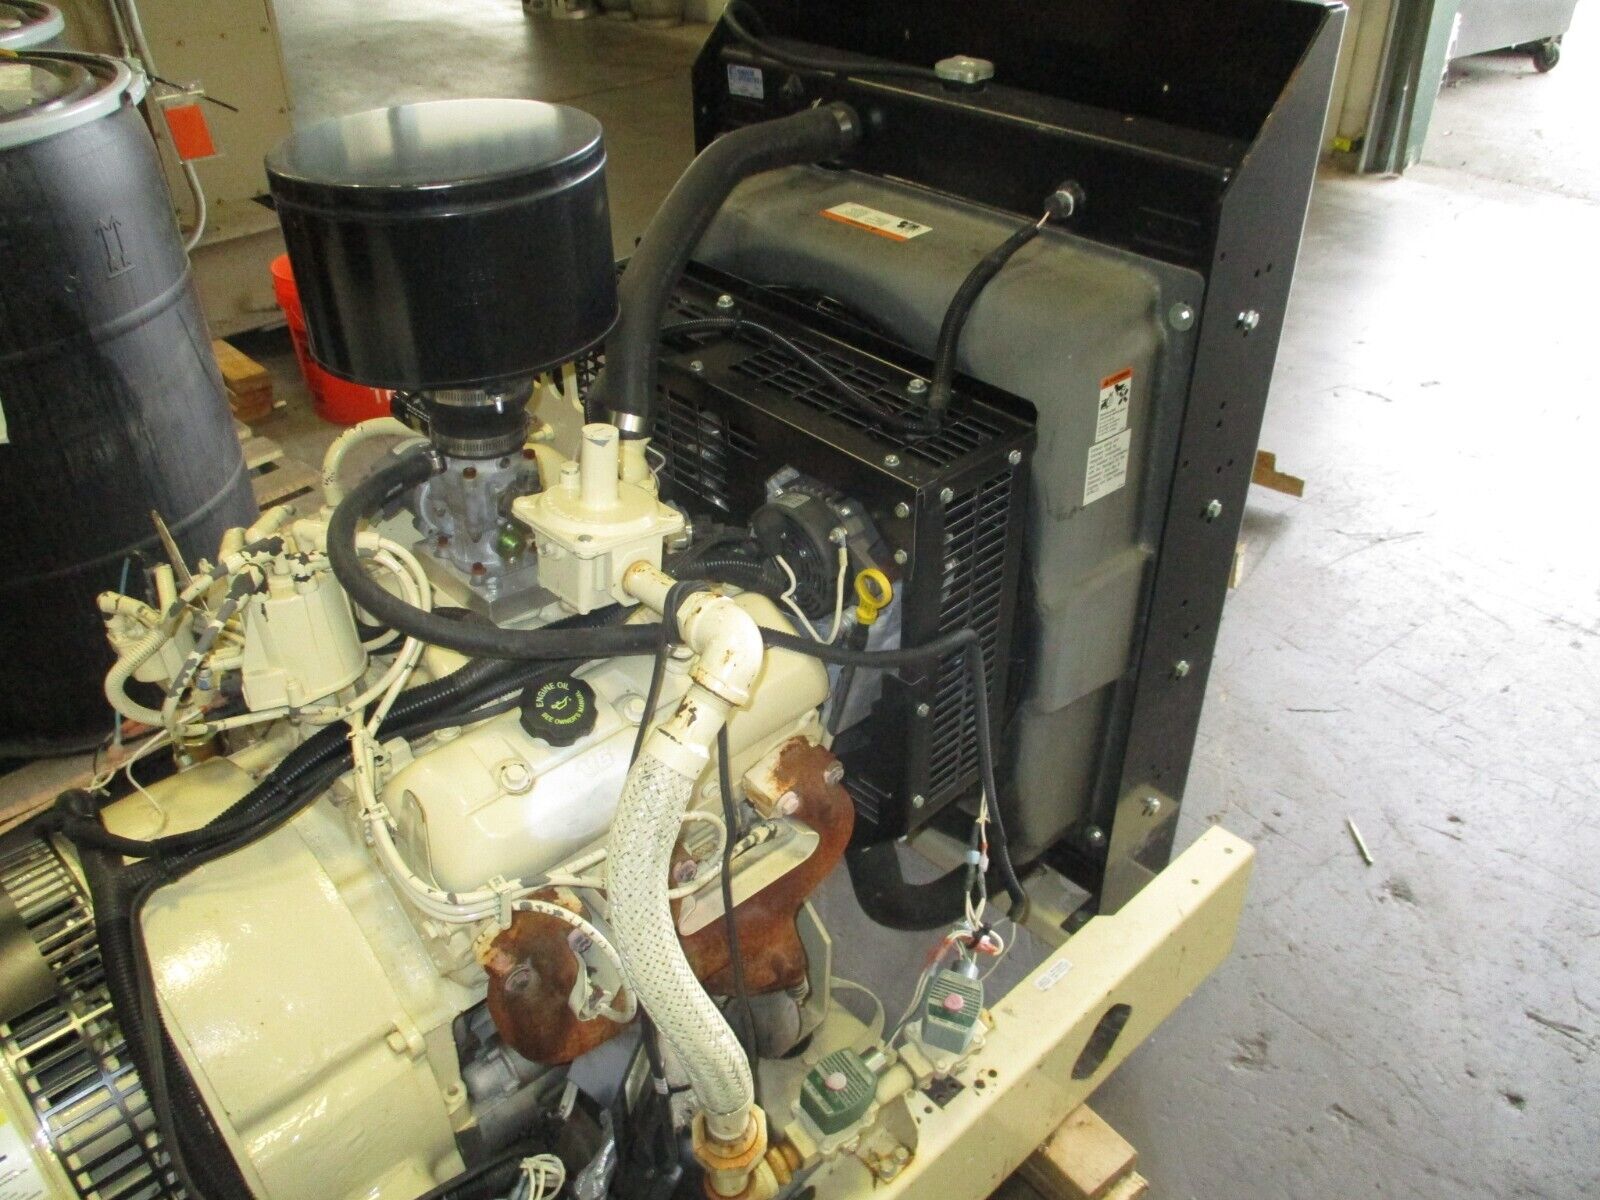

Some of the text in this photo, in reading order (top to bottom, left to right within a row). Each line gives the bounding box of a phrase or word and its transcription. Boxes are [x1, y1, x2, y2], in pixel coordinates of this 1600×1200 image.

[536, 681, 570, 708] ENGINE OIL
[541, 712, 554, 723] SEE
